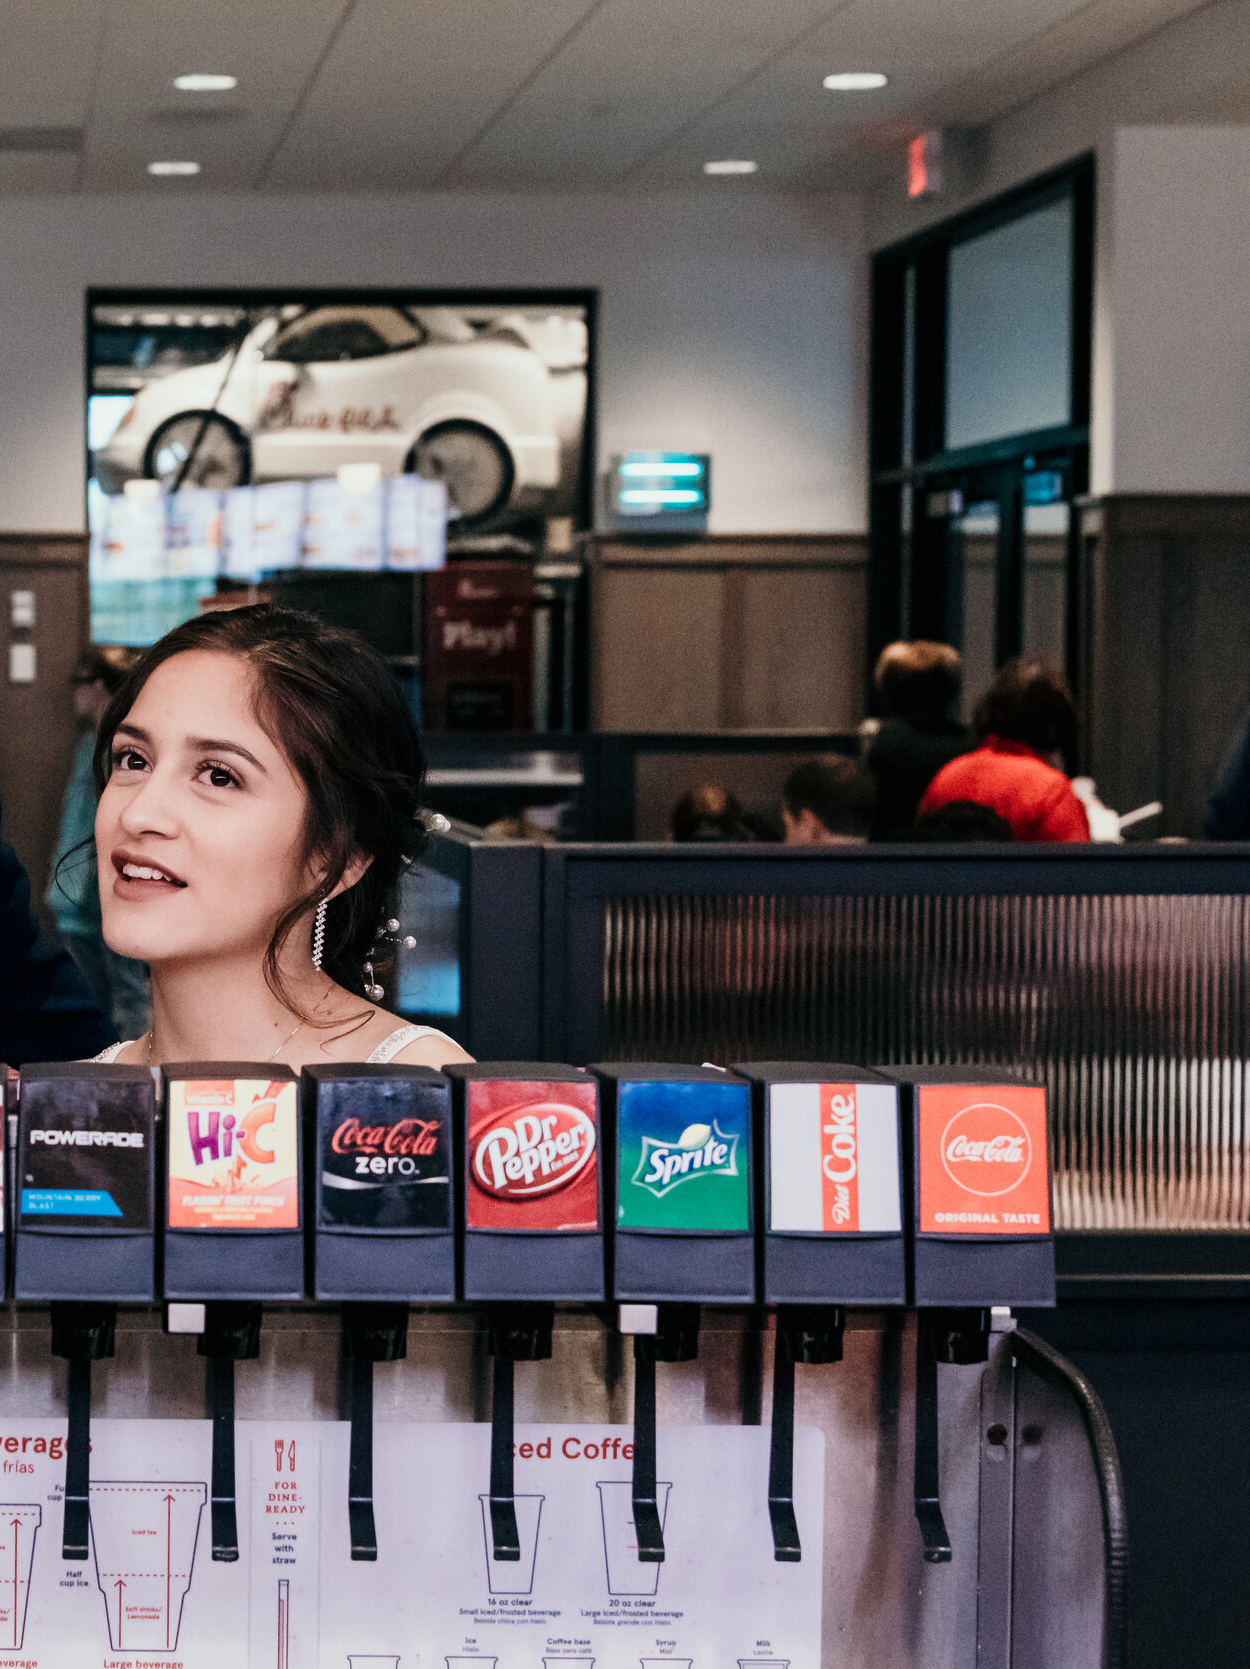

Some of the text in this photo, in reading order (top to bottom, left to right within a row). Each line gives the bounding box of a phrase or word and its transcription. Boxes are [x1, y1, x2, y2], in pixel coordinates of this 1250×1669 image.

[187, 1103, 277, 1166] Hi-C
[331, 1118, 442, 1155] Coca-Cola
[514, 1115, 558, 1151] Dr
[30, 1130, 144, 1148] POWERADE
[946, 1135, 1025, 1162] Coca-Cola
[485, 1124, 586, 1189] Pepper
[645, 1135, 728, 1184] Sprite
[823, 1094, 856, 1225] Diet Coke
[355, 1156, 416, 1175] zero
[74, 1194, 101, 1202] BERRY
[935, 1212, 1040, 1224] ORIGINAL TASTE
[513, 1437, 635, 1460] ed Coffe
[3, 1460, 35, 1474] frías
[274, 1482, 298, 1490] FOR
[47, 1494, 62, 1502] cup
[268, 1494, 303, 1502] DINE-
[265, 1505, 306, 1514] READY
[272, 1532, 297, 1540] Serve
[274, 1544, 293, 1552] with
[272, 1556, 296, 1564] straw
[487, 1598, 497, 1606] 16
[511, 1598, 533, 1606] clear
[609, 1599, 619, 1607] 20
[634, 1599, 656, 1607] clear
[480, 1608, 526, 1616] iced/frosted
[528, 1609, 561, 1617] beverage
[602, 1609, 649, 1617] iced/frosted
[650, 1610, 684, 1618] beverage
[103, 1659, 184, 1669] Large beverage
